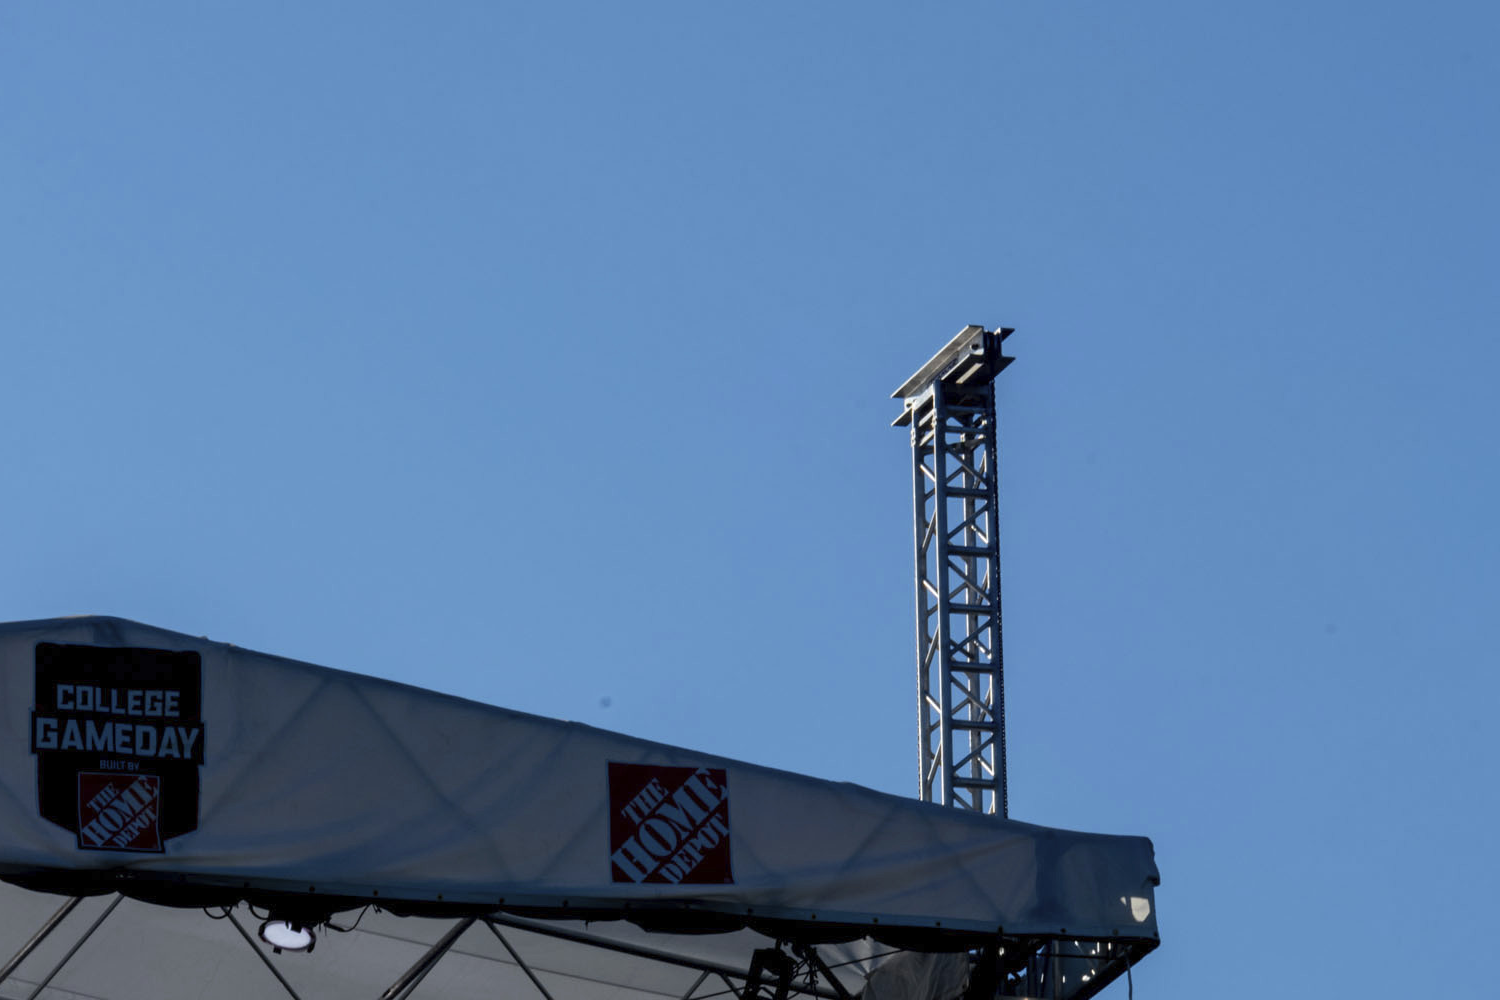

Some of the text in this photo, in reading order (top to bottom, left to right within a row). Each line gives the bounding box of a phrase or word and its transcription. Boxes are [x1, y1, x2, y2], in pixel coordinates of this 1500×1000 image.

[56, 683, 180, 717] COLLEGE
[35, 717, 200, 759] GAMEDAY
[99, 759, 140, 771] BUILT BY
[82, 776, 159, 847] HOME
[86, 782, 121, 813] THE
[620, 776, 670, 826] THE
[112, 804, 158, 848] DEPOT
[611, 768, 728, 884] HOME
[659, 812, 729, 885] DEPOT
